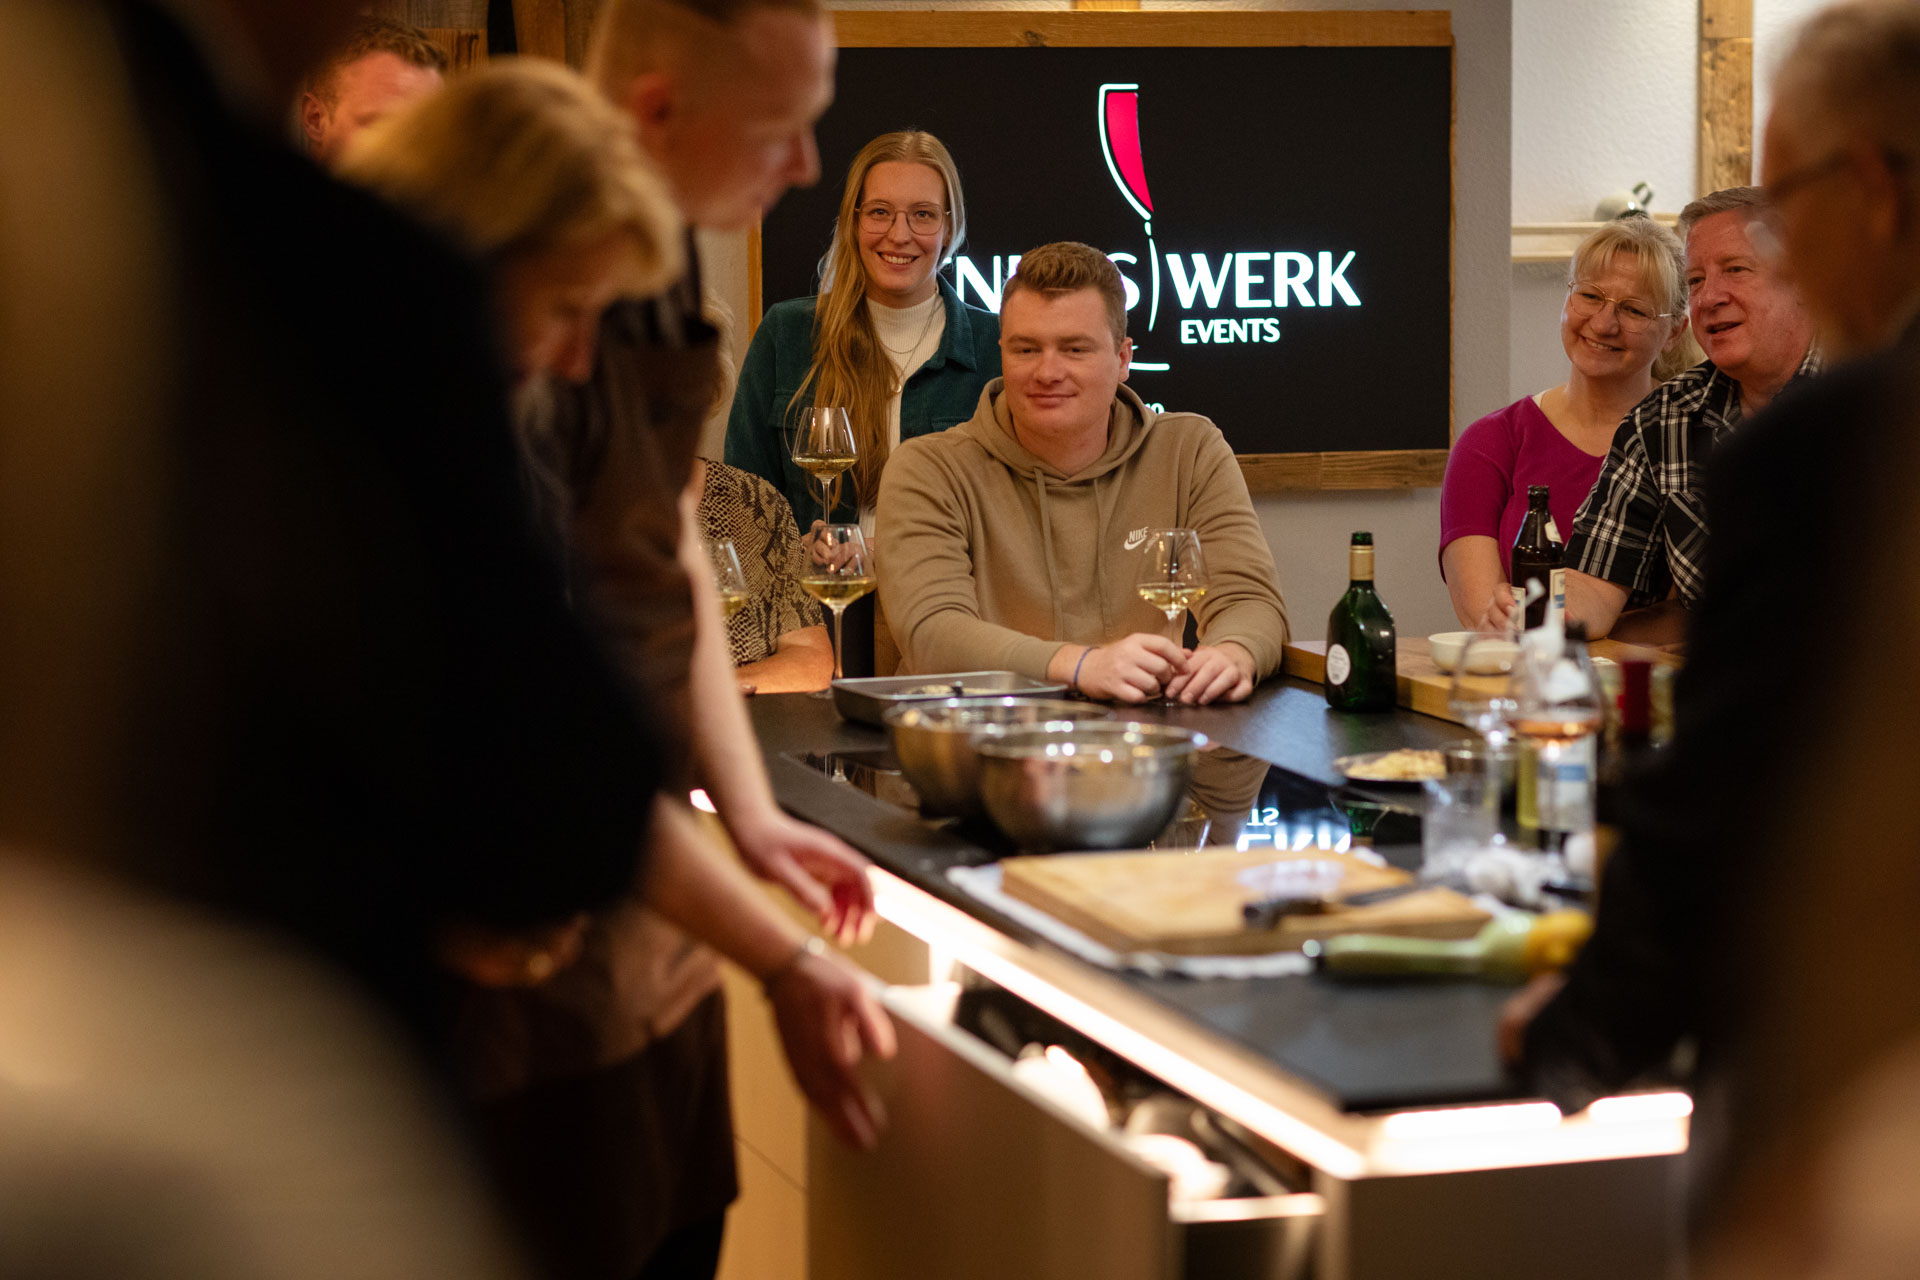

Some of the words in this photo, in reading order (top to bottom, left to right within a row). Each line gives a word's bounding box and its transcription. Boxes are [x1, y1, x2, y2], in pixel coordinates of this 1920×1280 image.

[1165, 250, 1362, 309] WERK
[1180, 317, 1280, 344] EVENTS
[1128, 526, 1149, 542] NIKE
